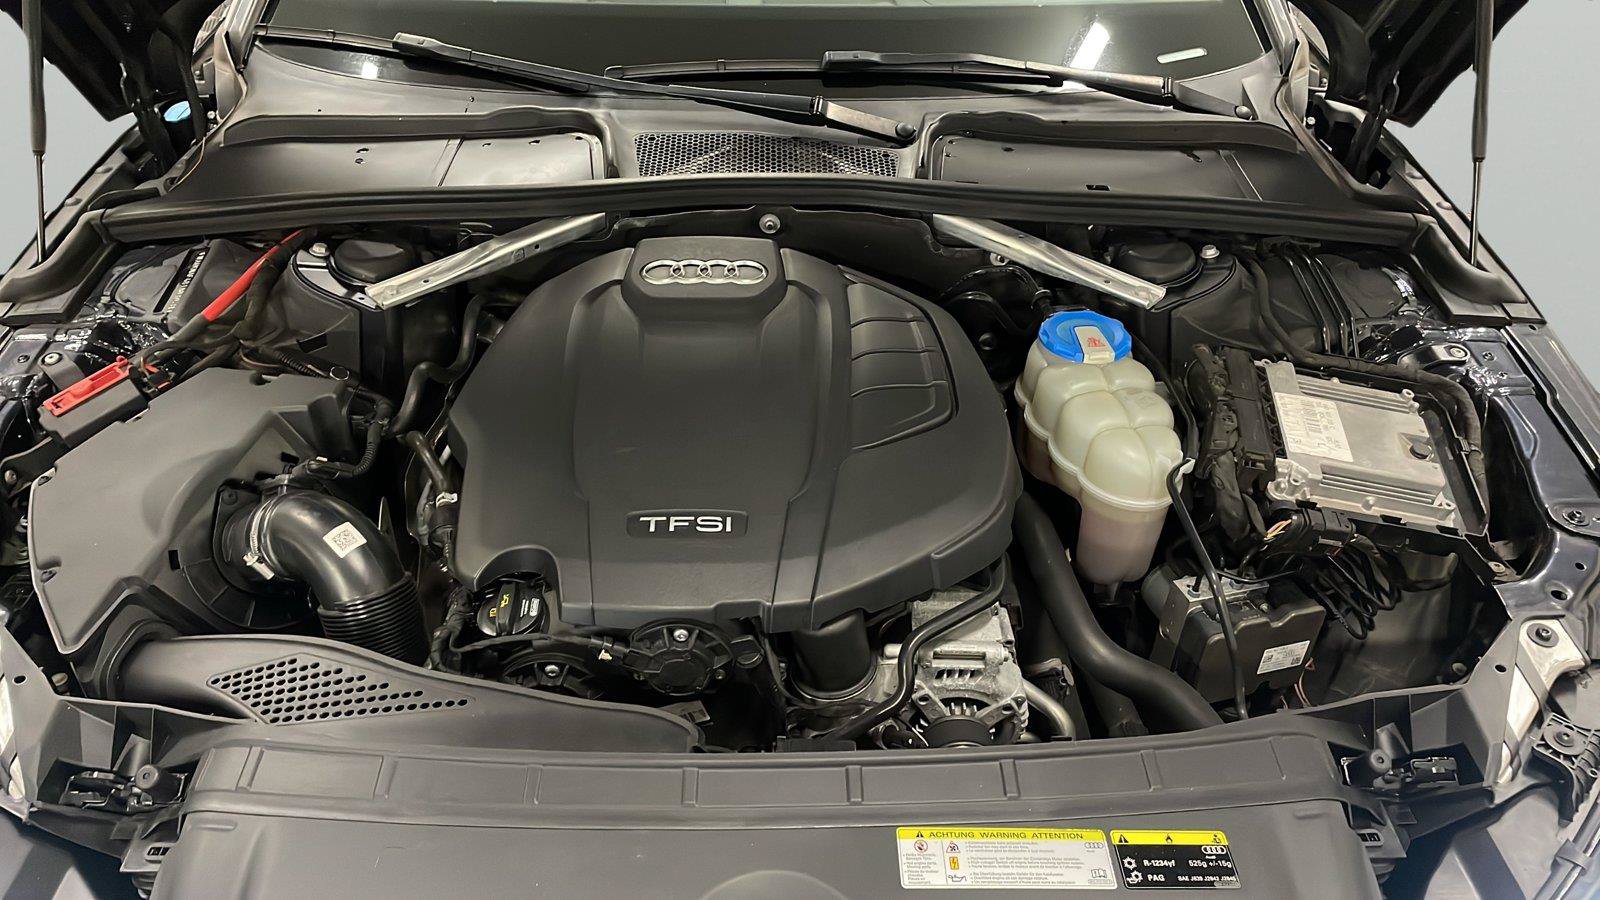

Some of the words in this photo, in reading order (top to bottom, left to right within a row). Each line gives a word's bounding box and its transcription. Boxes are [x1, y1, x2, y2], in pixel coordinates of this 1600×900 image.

[639, 516, 732, 533] TFSI
[979, 831, 1027, 839] WARNING
[1143, 859, 1176, 868] R-1234yf
[1188, 860, 1208, 868] 525g
